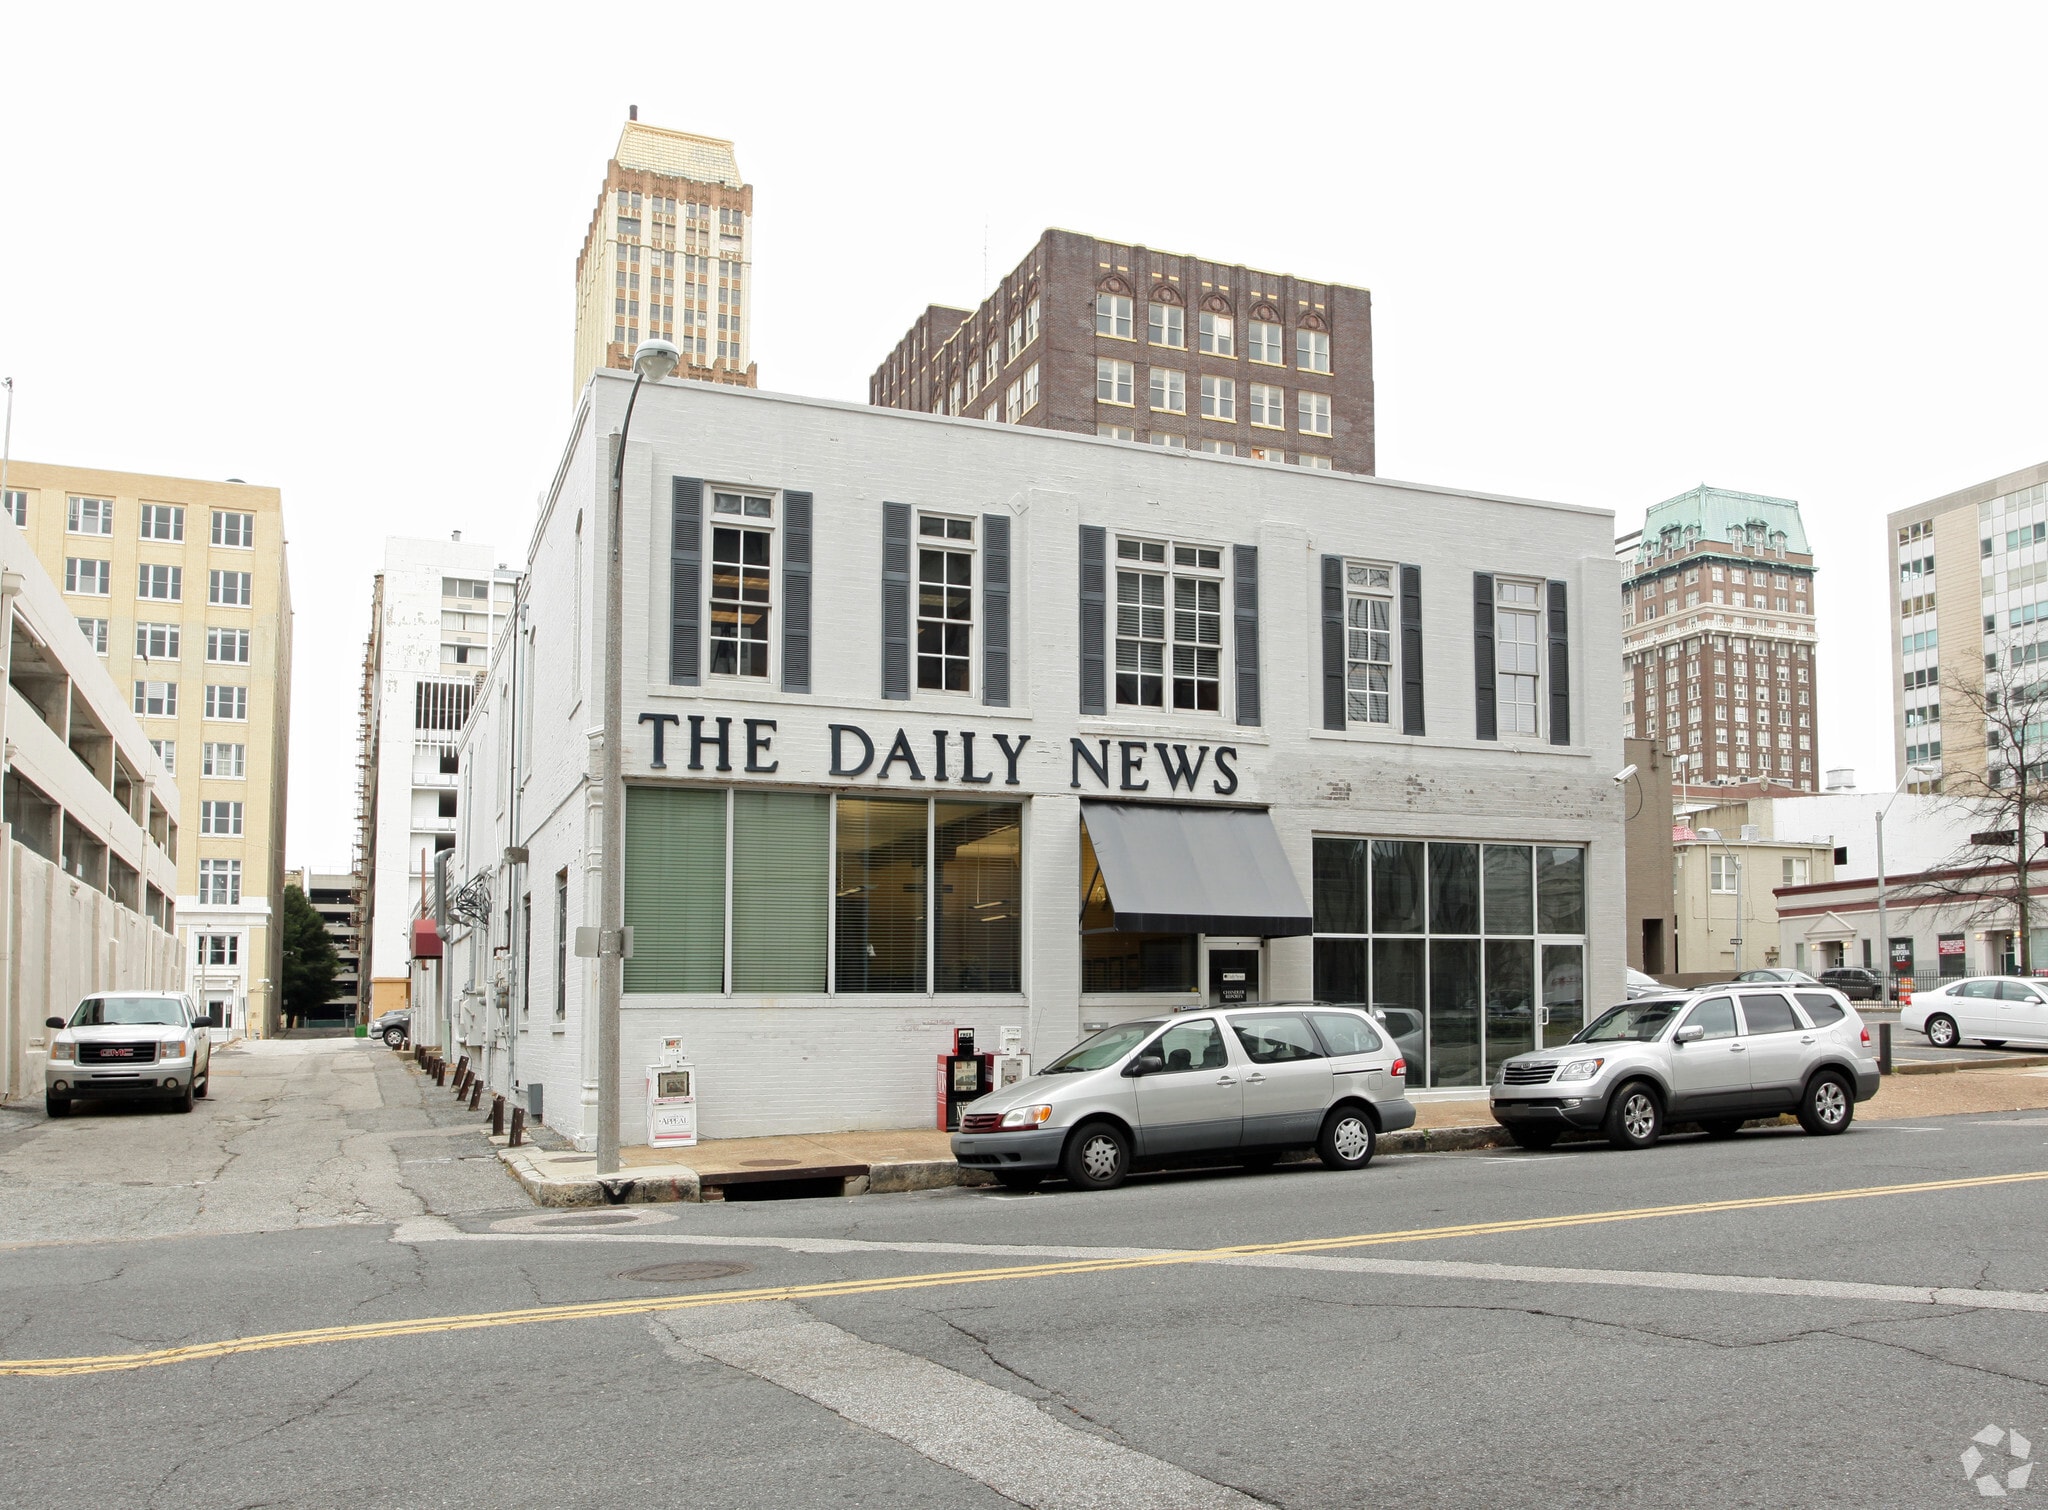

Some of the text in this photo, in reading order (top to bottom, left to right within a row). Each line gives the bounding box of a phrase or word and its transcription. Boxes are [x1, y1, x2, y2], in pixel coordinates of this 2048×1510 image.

[638, 712, 1239, 794] THE DAILY NEWS
[100, 1048, 134, 1057] GMC
